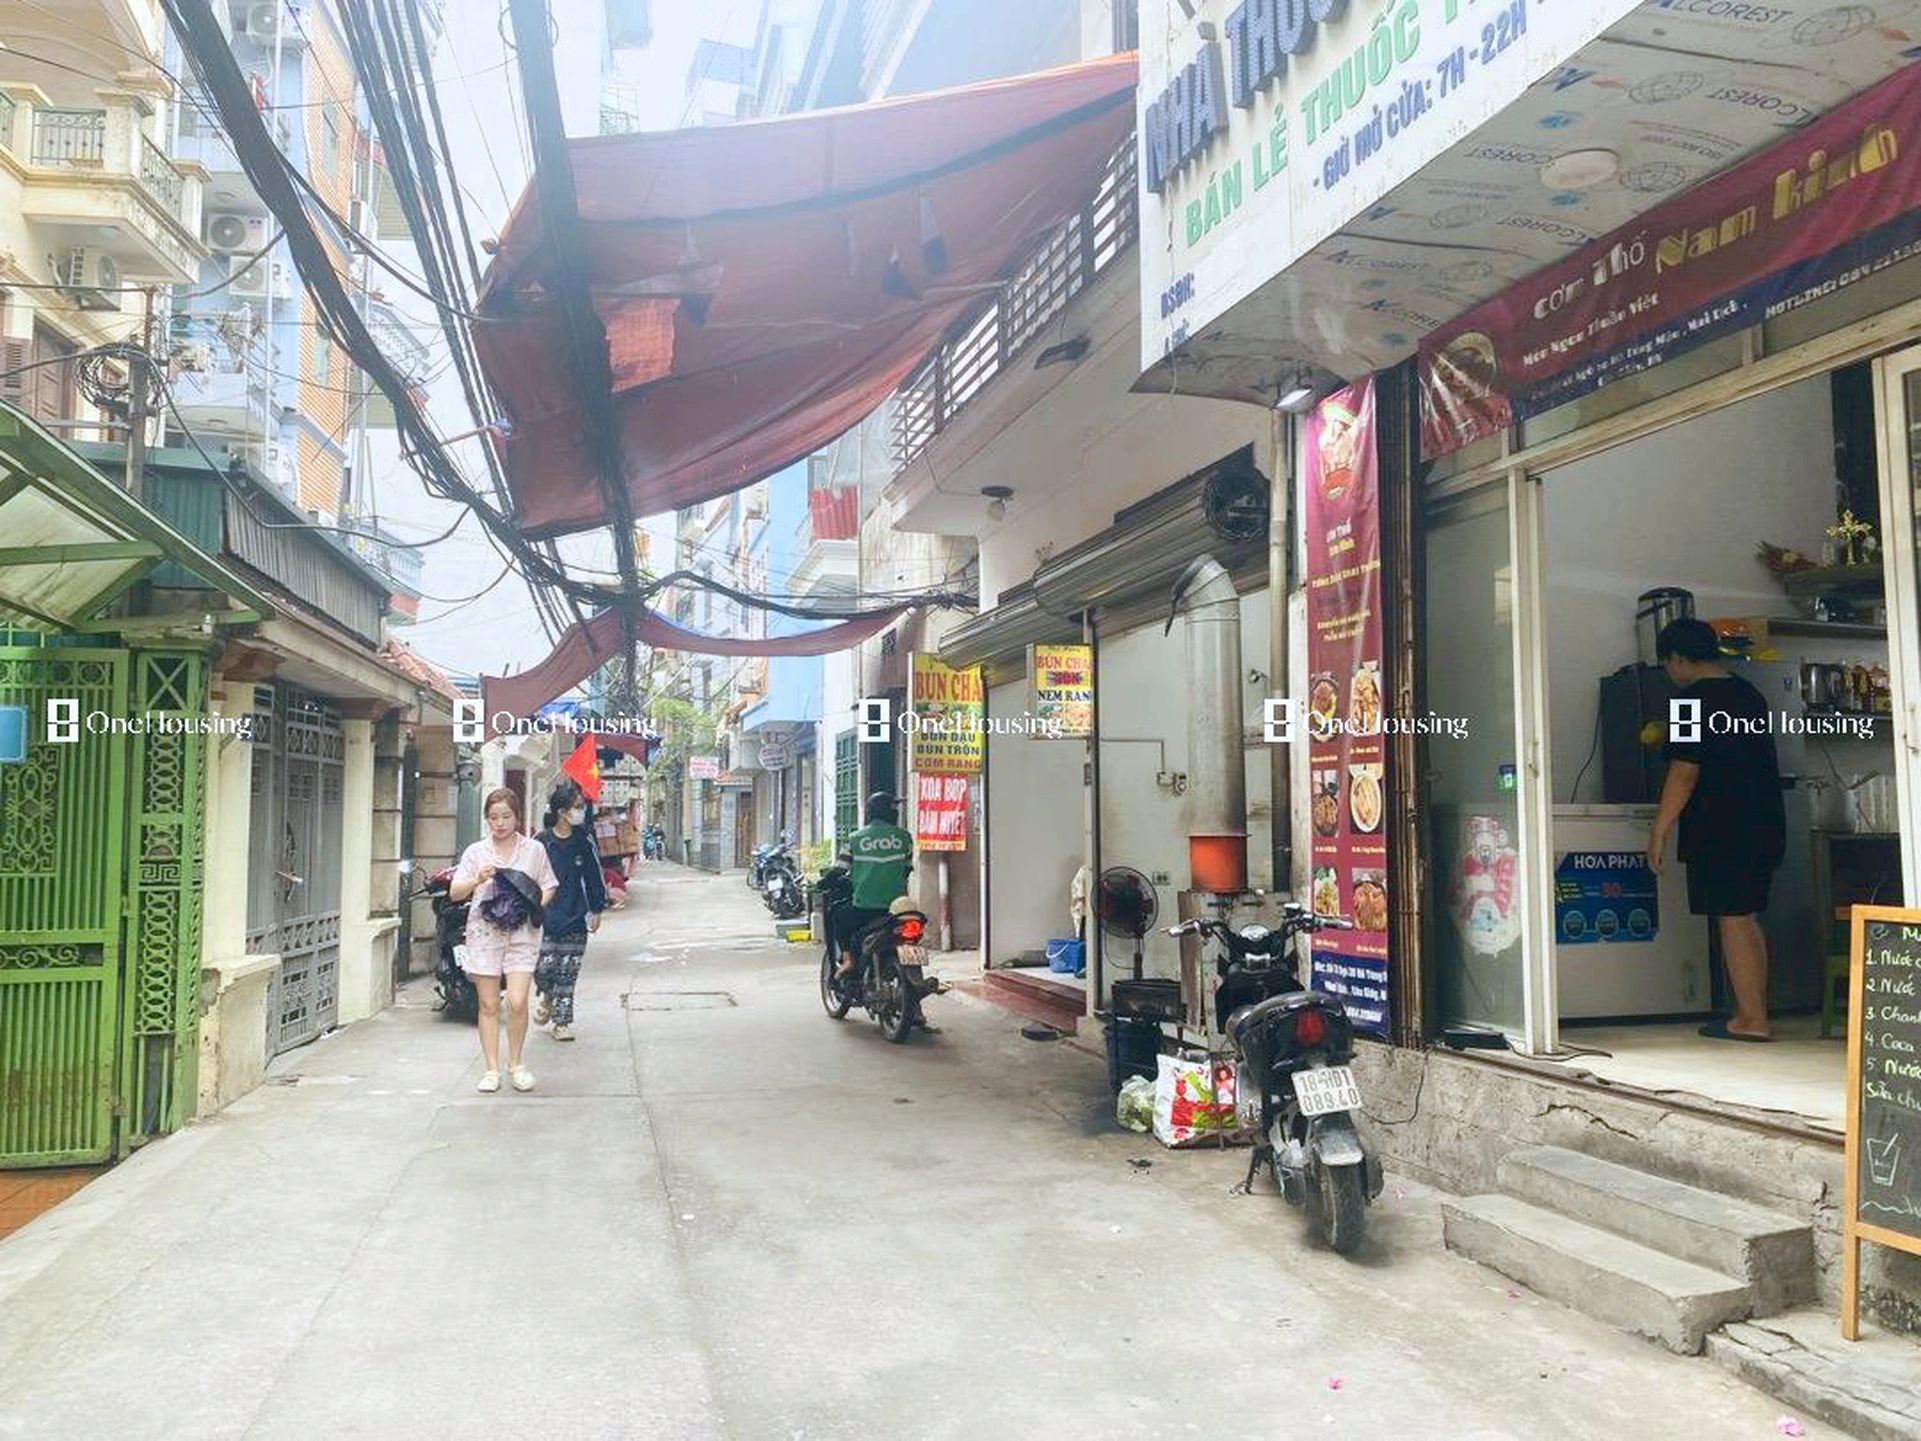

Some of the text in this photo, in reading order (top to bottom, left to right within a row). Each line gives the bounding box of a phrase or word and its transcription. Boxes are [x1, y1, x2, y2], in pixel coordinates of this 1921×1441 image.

[1387, 80, 1432, 138] CỬA:
[1437, 46, 1464, 98] 7H
[1481, 0, 1527, 65] 22H
[1185, 0, 1420, 248] BÁN LẺ THUỐC
[859, 834, 902, 851] Grab
[1881, 1033, 1914, 1053] Coca
